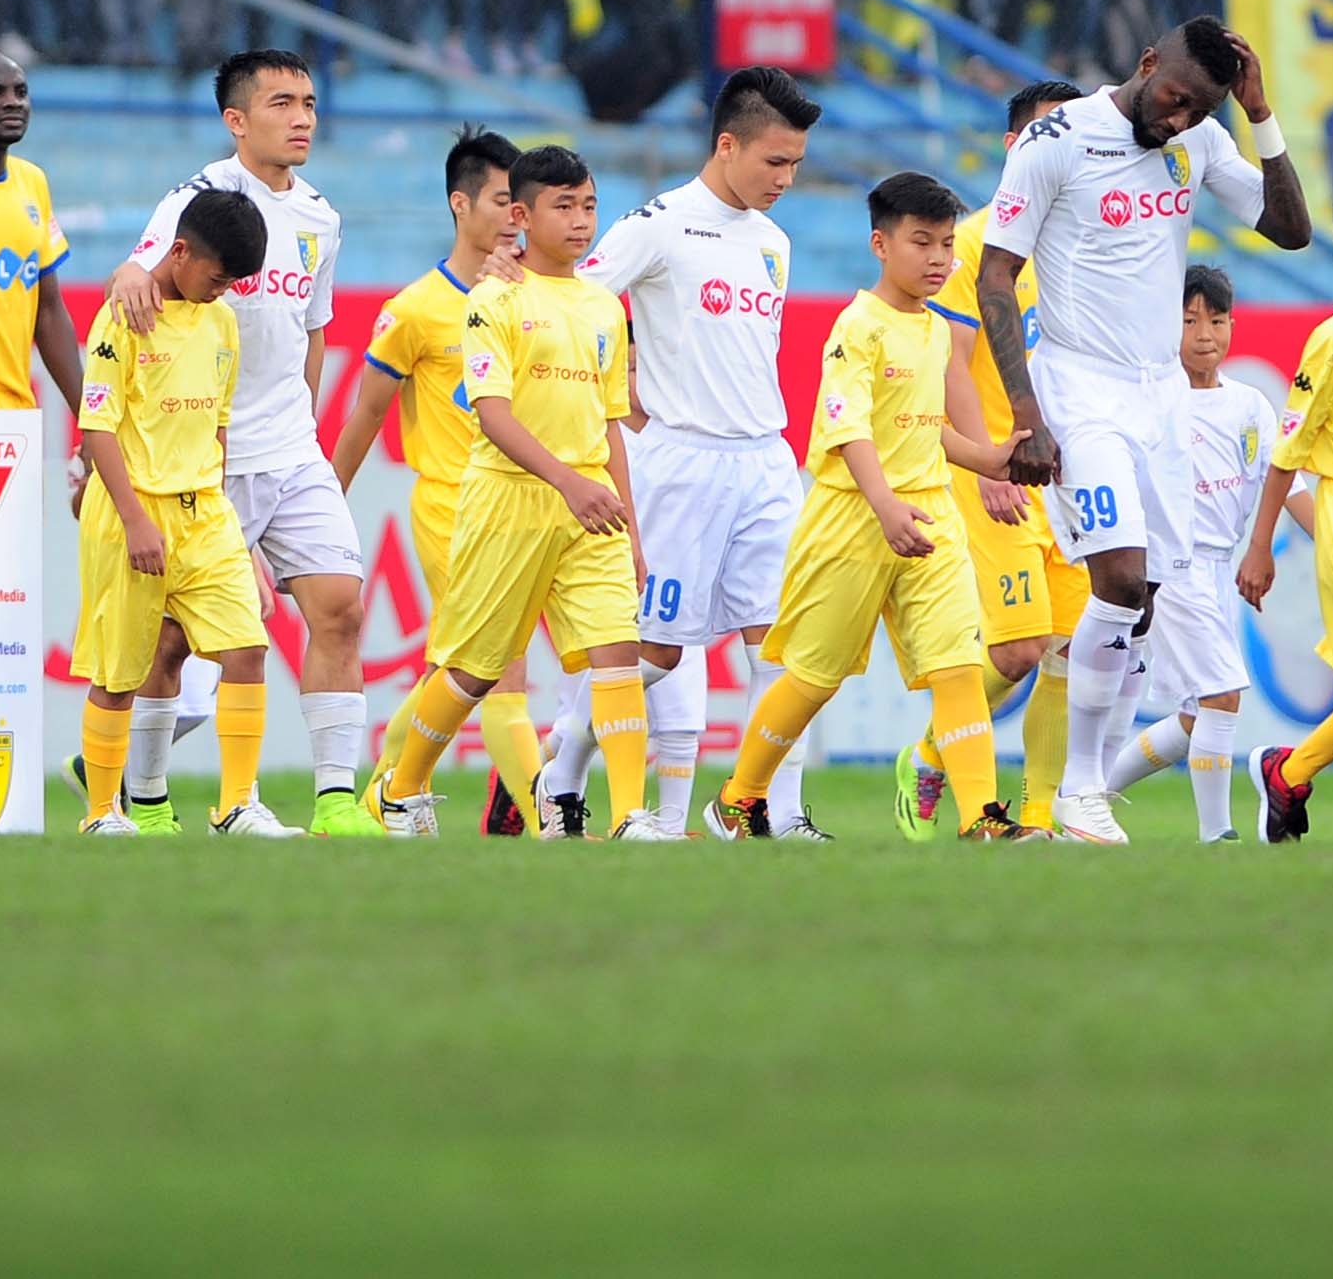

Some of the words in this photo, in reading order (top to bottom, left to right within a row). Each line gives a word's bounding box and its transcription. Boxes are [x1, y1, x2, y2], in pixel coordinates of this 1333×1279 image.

[1086, 147, 1126, 157] Kappa
[1139, 188, 1191, 219] SCG
[684, 228, 721, 238] Kappa
[148, 353, 172, 363] SCG
[183, 397, 220, 410] TOYOT
[915, 413, 947, 427] TOYO
[1075, 485, 1118, 532] 39
[998, 570, 1032, 608] 27
[641, 574, 682, 623] 19
